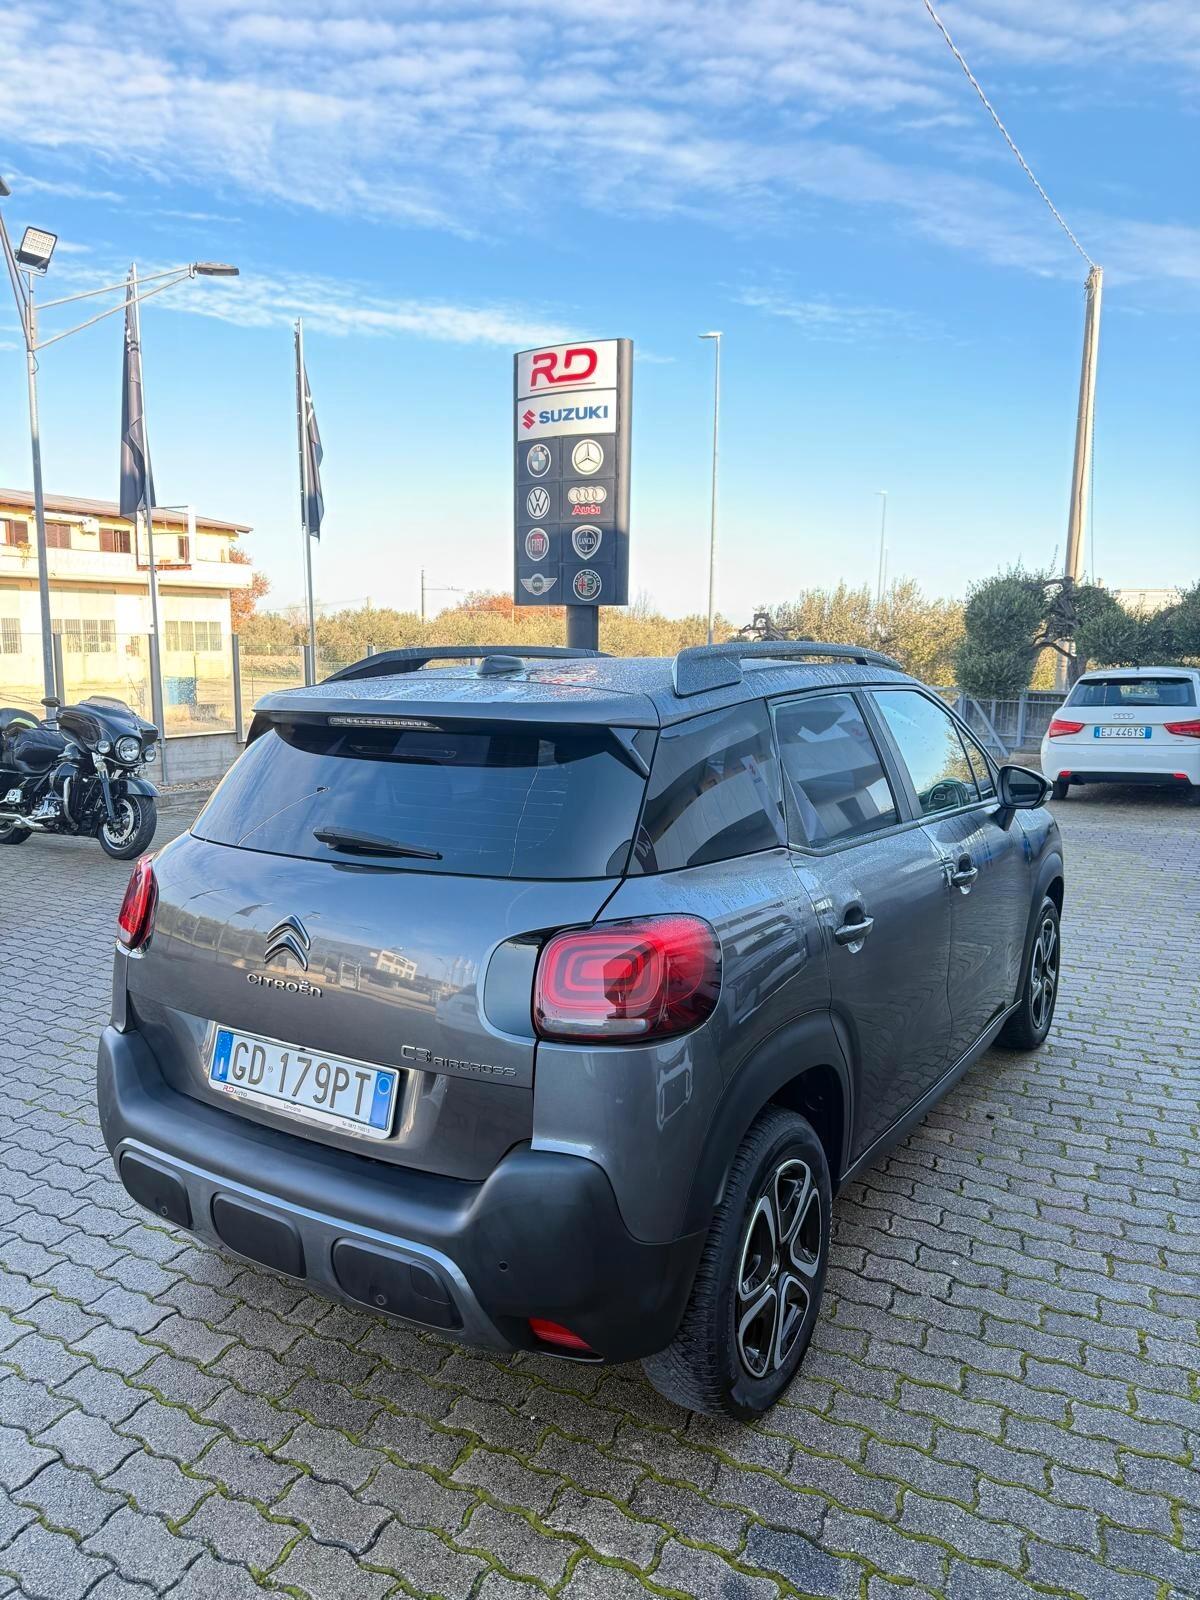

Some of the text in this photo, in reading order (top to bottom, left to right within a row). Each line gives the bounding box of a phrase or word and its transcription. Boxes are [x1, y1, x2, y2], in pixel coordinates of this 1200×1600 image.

[530, 348, 597, 387] RD
[538, 405, 608, 424] SUZUKI
[572, 504, 601, 515] Audi
[531, 538, 544, 551] FIAT
[579, 537, 594, 545] LANCIA
[401, 1045, 517, 1077] C3 AIRCROSS
